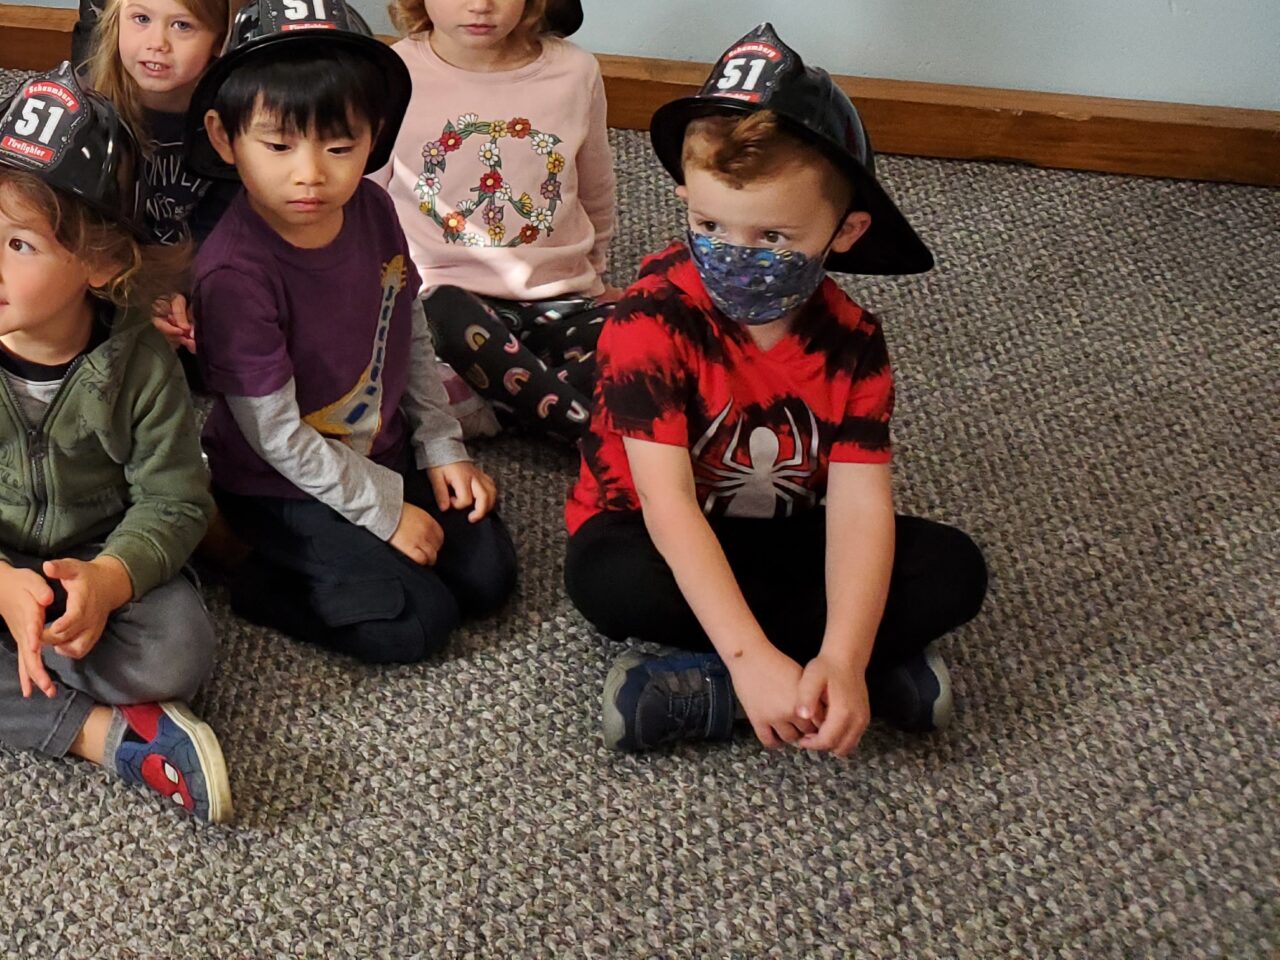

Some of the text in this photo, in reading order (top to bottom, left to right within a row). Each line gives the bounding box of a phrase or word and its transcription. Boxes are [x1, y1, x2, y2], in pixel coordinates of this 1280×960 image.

[717, 58, 767, 91] 51
[28, 84, 75, 107] Schaumburg
[14, 97, 65, 145] 51
[7, 138, 46, 157] Firefighter
